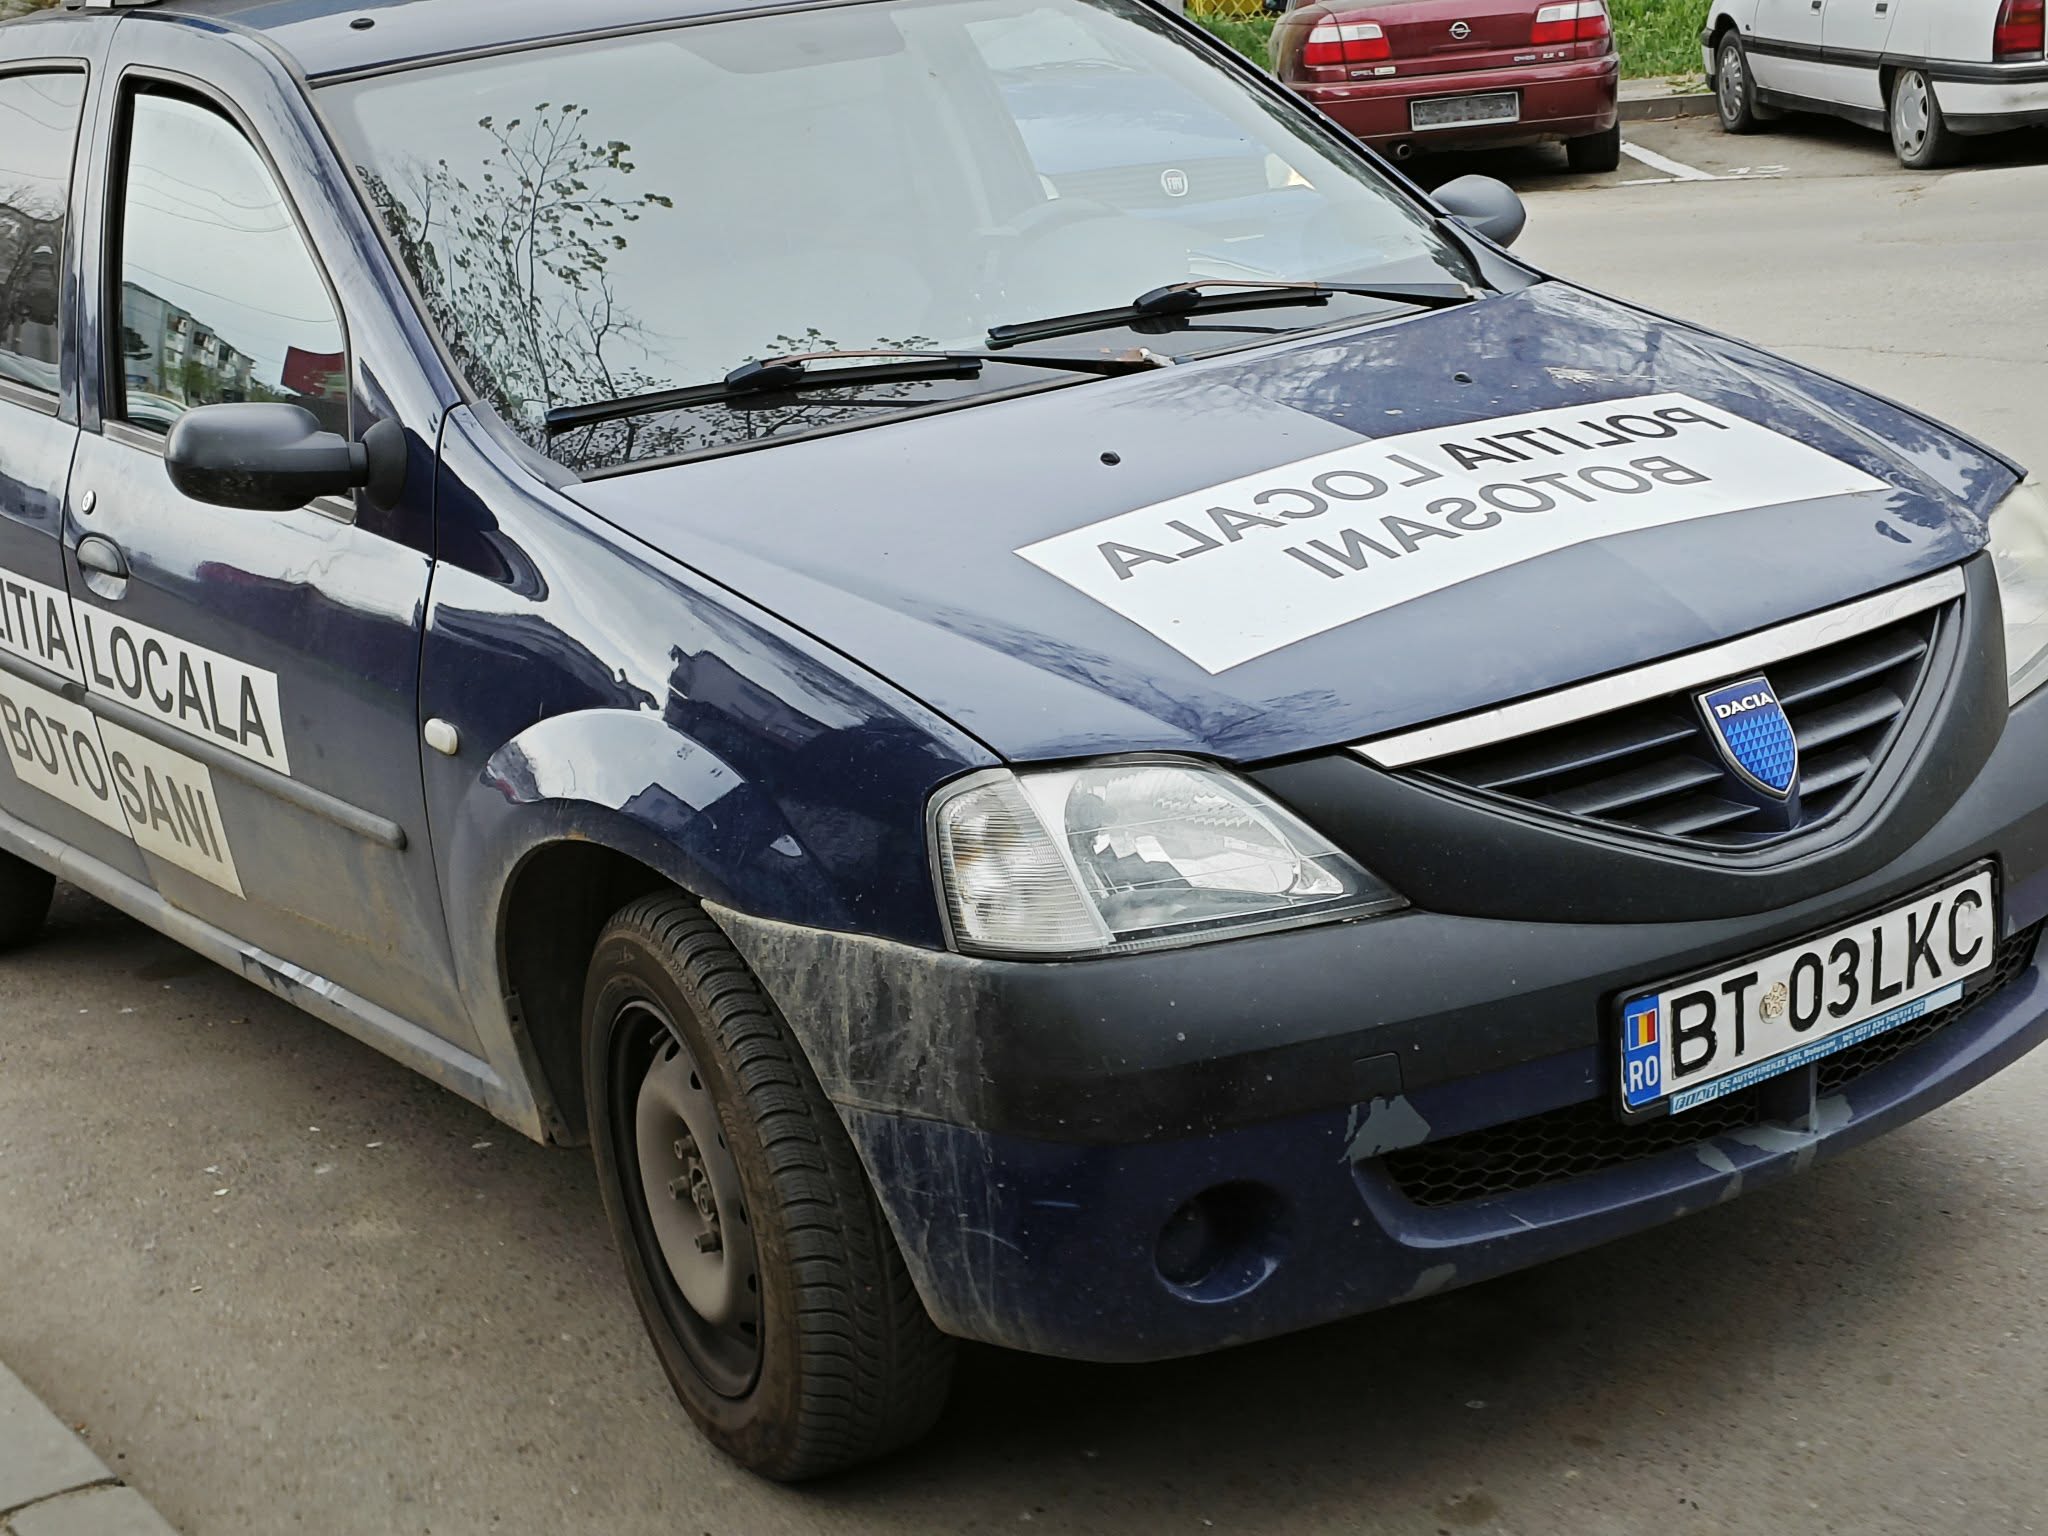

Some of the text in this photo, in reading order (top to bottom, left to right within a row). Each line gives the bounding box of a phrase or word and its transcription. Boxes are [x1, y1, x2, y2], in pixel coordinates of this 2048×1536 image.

[0, 578, 274, 758] ITIA LOCALA
[1714, 691, 1775, 719] DACIA
[1671, 971, 1758, 1080] BT
[1628, 1055, 1659, 1093] RO
[1675, 1084, 1718, 1112] FIAT
